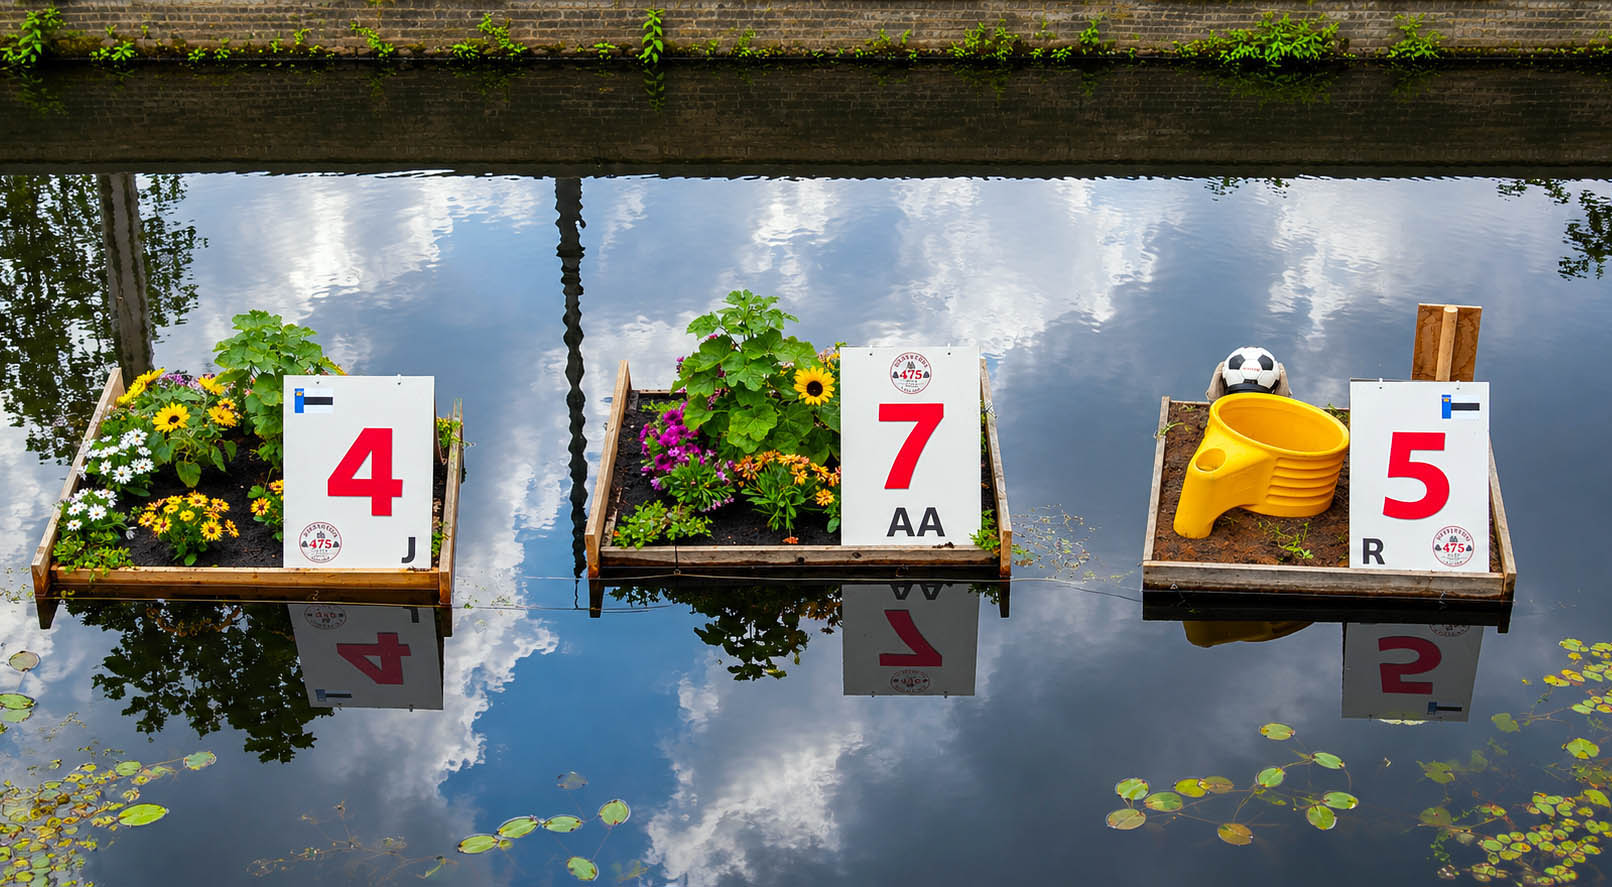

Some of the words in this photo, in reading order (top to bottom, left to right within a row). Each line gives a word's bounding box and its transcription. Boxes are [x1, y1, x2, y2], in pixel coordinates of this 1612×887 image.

[899, 369, 923, 380] 475
[878, 403, 944, 489] 7
[327, 427, 403, 517] 4
[1382, 431, 1450, 520] 5
[886, 507, 946, 537] AA
[309, 538, 332, 549] 475
[401, 536, 416, 564] J
[1362, 538, 1386, 565] R
[1442, 542, 1465, 553] 475
